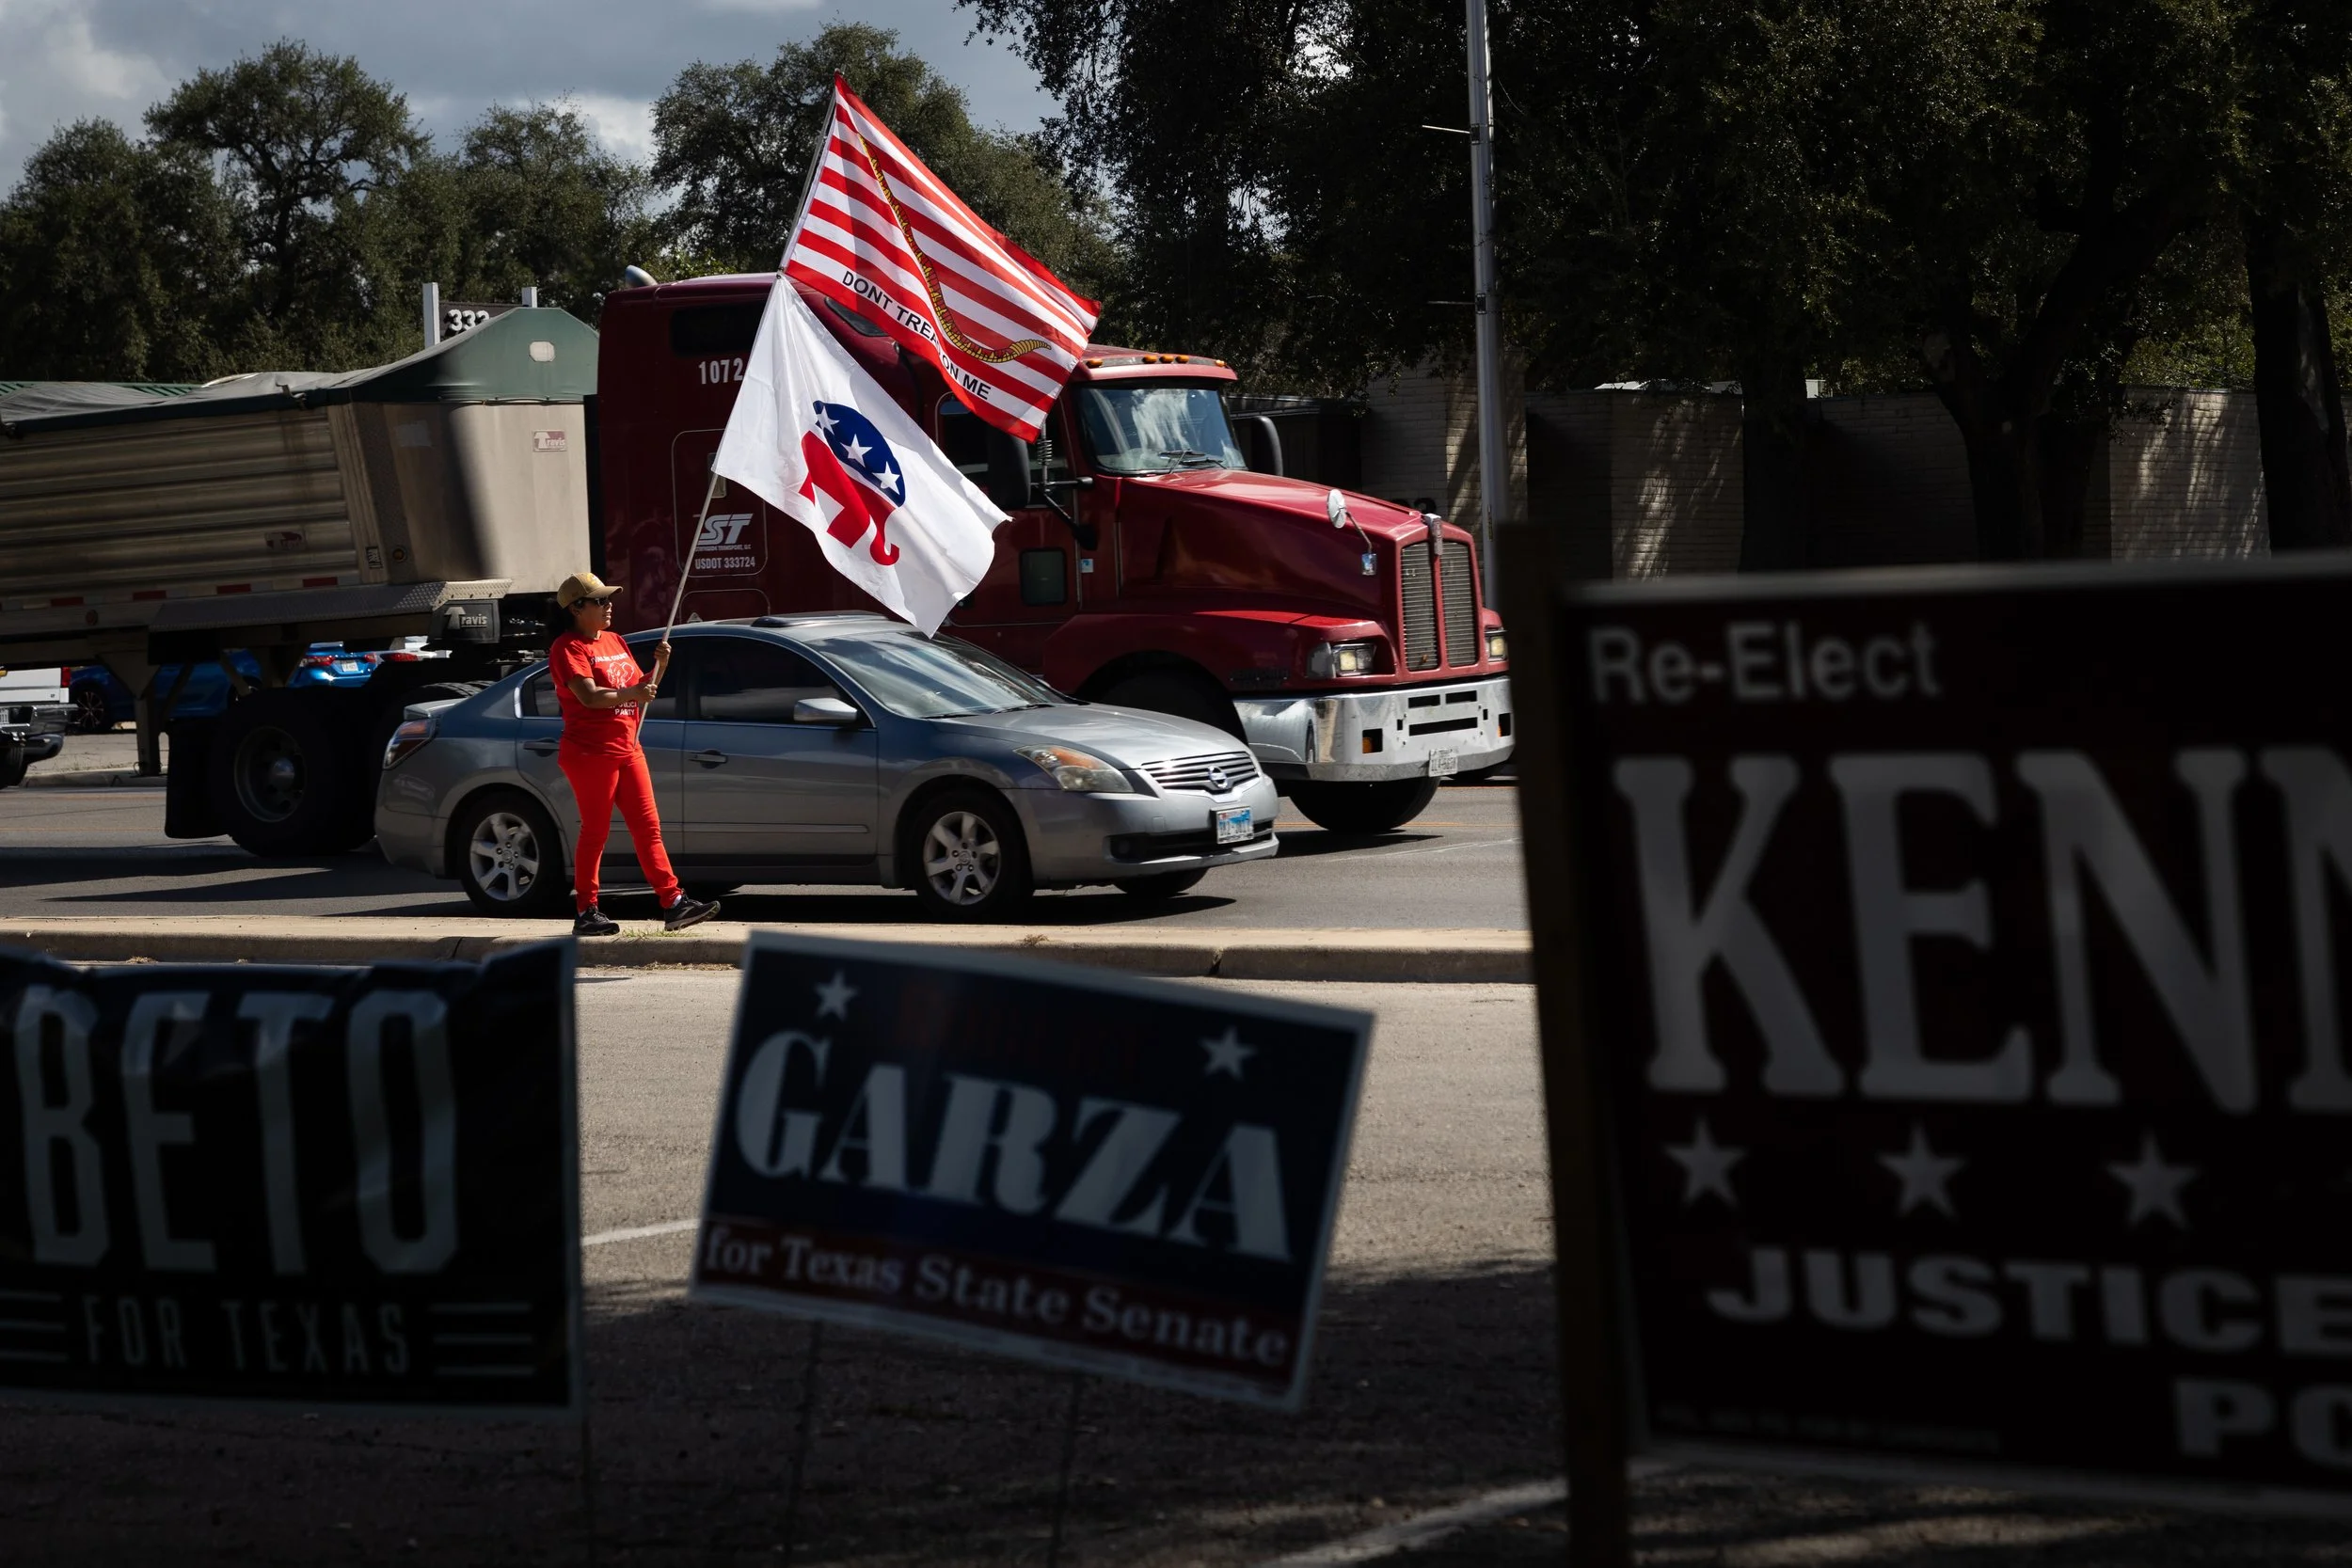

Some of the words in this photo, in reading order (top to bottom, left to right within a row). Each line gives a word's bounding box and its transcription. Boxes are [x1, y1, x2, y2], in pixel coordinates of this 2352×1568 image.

[842, 270, 893, 310] DONT
[897, 306, 940, 354] TREA
[942, 354, 959, 380] ON
[962, 373, 992, 400] ME
[444, 607, 488, 630] Travis
[695, 557, 722, 570] USDOT
[723, 556, 755, 569] 333724
[1584, 617, 1945, 706] Re-Elect
[12, 983, 460, 1277] BETO
[733, 1028, 1294, 1263] GARZA
[81, 1293, 188, 1370] FOR
[219, 1298, 411, 1377] TEXAS
[706, 1225, 772, 1275] for
[780, 1233, 906, 1294] Texas
[913, 1253, 1072, 1325] State
[1080, 1284, 1289, 1368] Senate
[1702, 1243, 2352, 1361] JUSTICE
